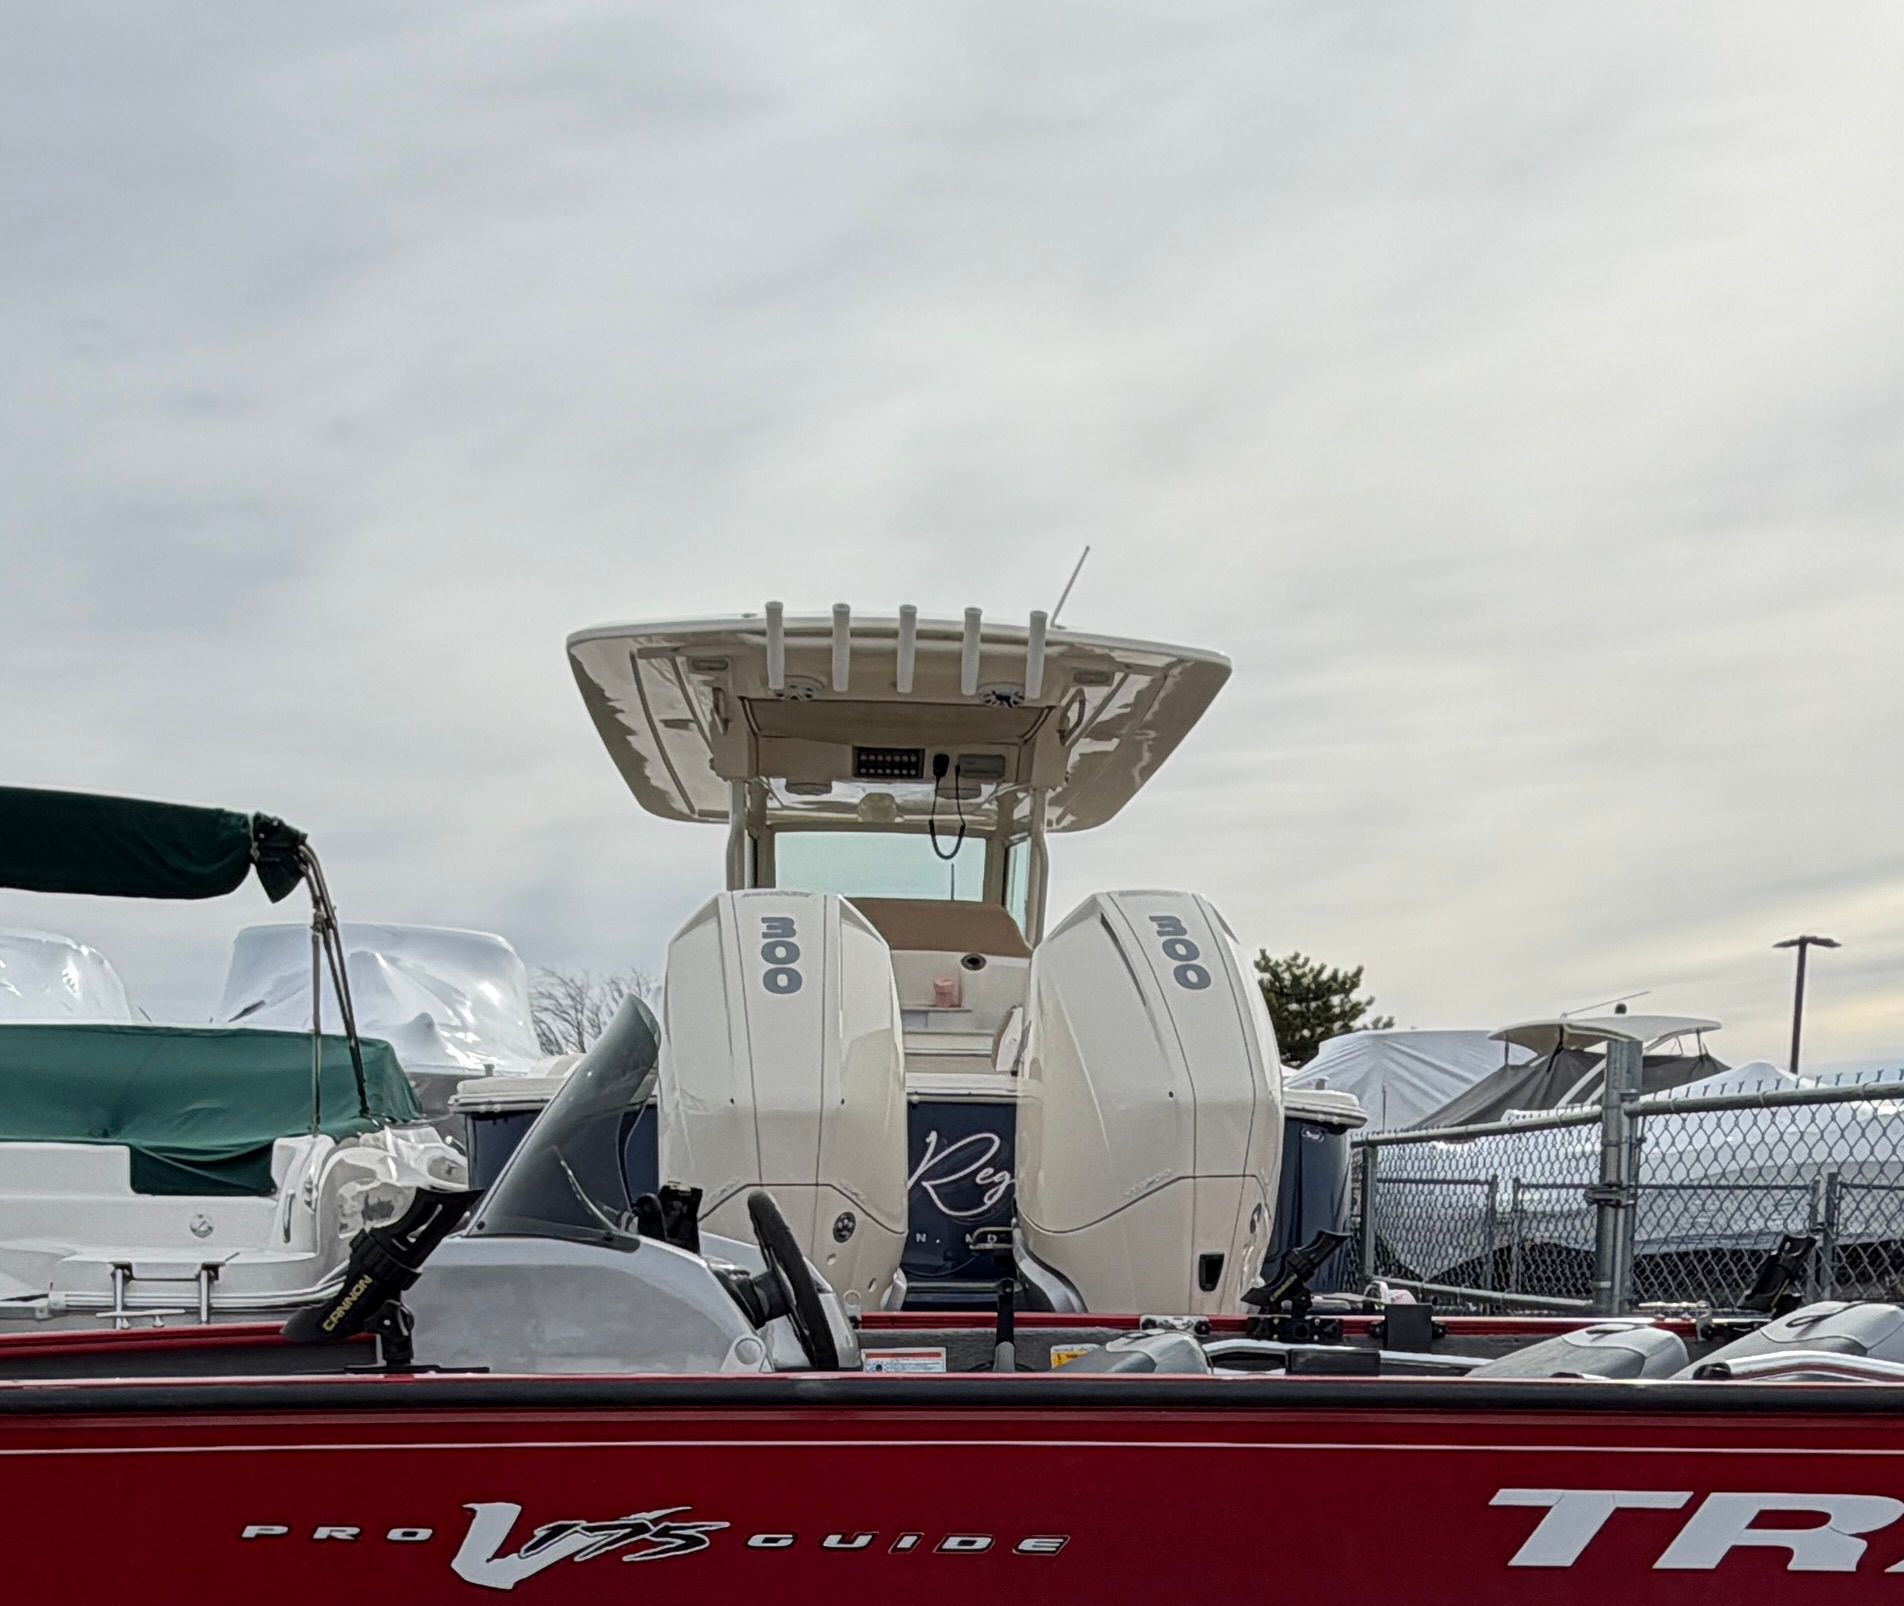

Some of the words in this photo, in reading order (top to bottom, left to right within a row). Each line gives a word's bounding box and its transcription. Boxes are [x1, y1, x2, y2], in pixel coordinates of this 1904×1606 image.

[761, 917, 802, 993] 300
[1149, 915, 1210, 989] 300
[322, 1274, 373, 1332] CANNON
[241, 1523, 434, 1543] PRO
[746, 1532, 1073, 1557] GUIDE
